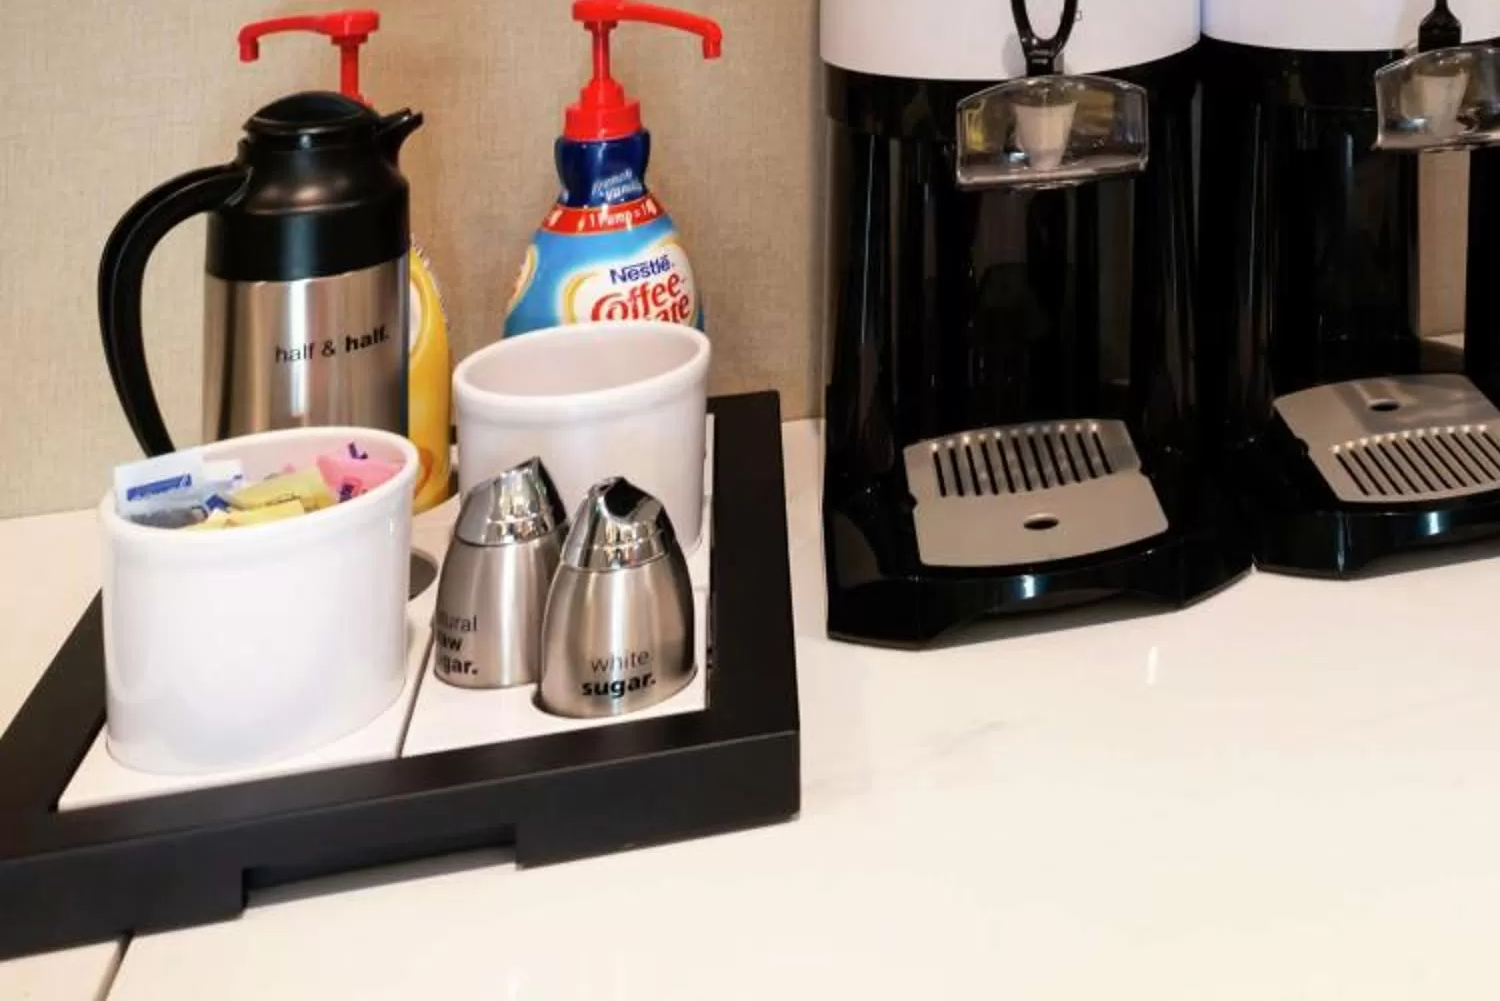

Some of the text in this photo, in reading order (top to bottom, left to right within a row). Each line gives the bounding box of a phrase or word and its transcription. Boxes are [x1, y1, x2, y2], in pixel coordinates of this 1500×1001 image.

[609, 255, 671, 285] Nestlé
[275, 342, 315, 363] half
[321, 340, 336, 357] &
[590, 650, 649, 675] white
[581, 672, 657, 698] sugar.
